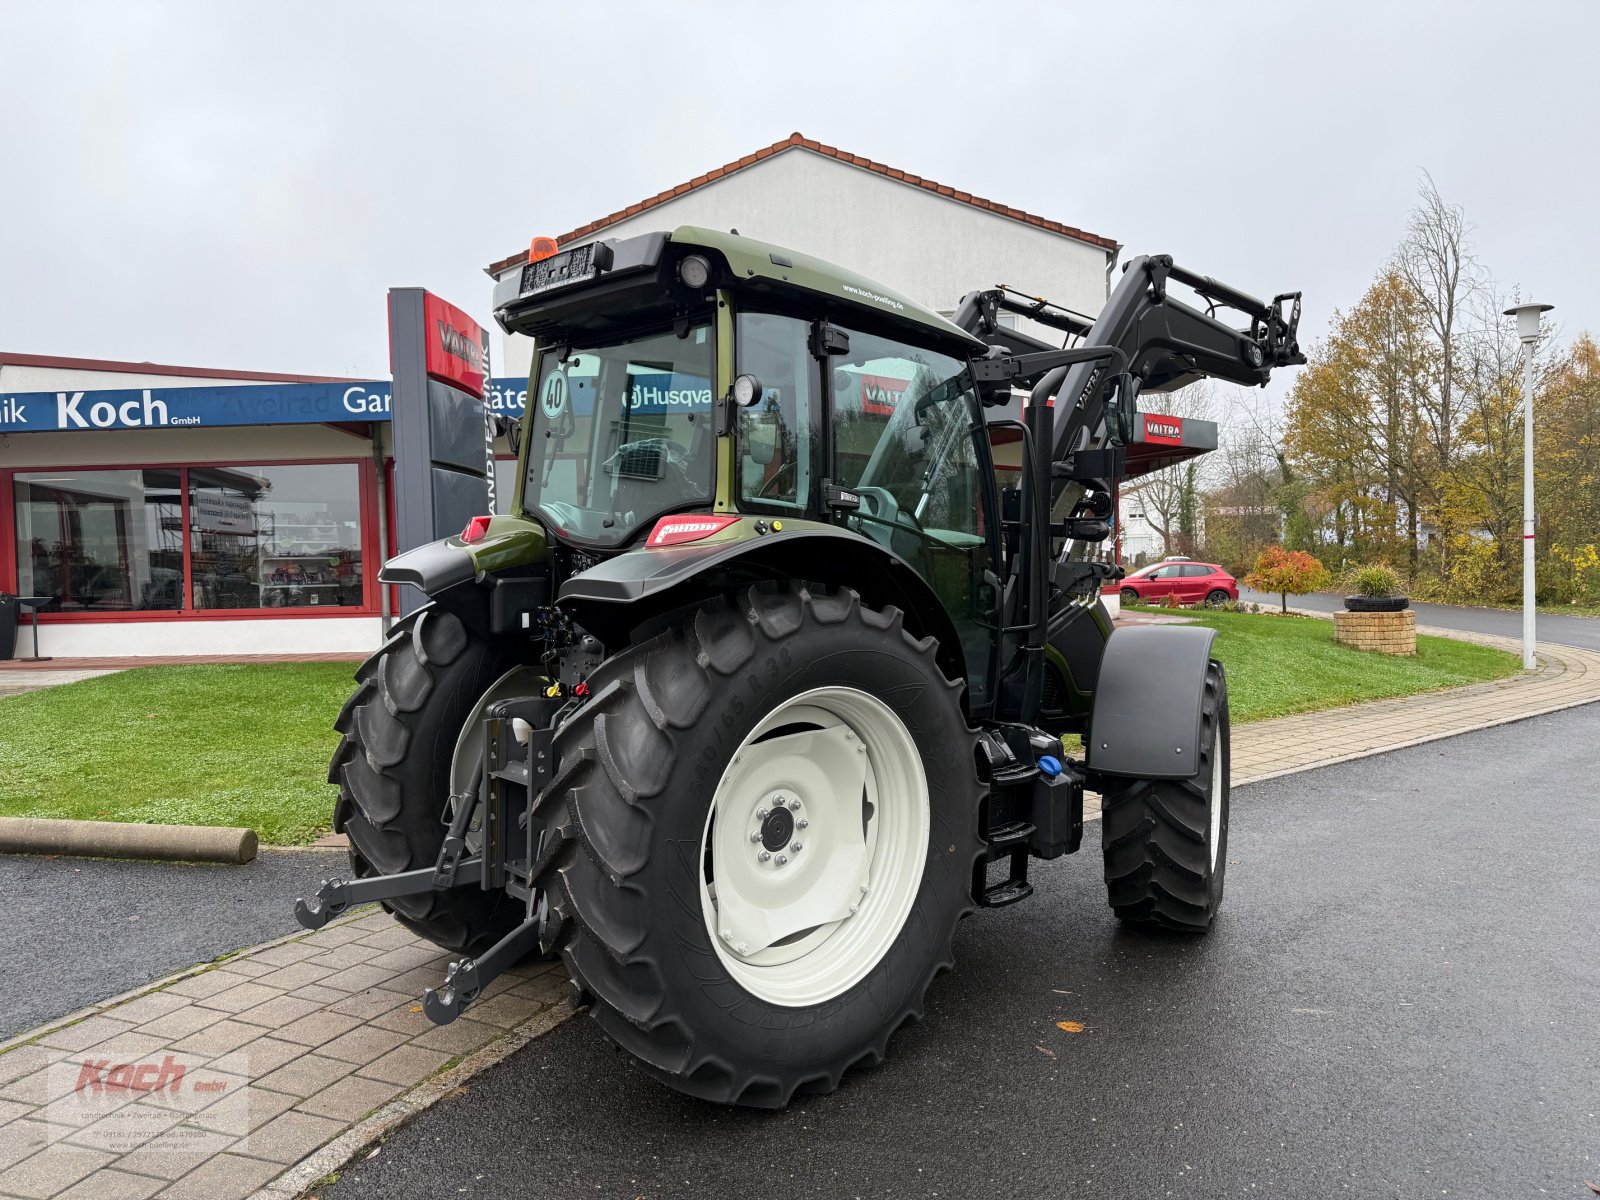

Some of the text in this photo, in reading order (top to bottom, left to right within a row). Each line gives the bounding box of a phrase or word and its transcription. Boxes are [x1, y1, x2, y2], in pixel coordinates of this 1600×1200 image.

[545, 377, 563, 409] 40
[1076, 368, 1100, 410] VALTRA
[0, 397, 28, 424] ik
[56, 389, 168, 428] Koch
[171, 416, 201, 425] GmbH
[1146, 422, 1181, 438] VALTRA
